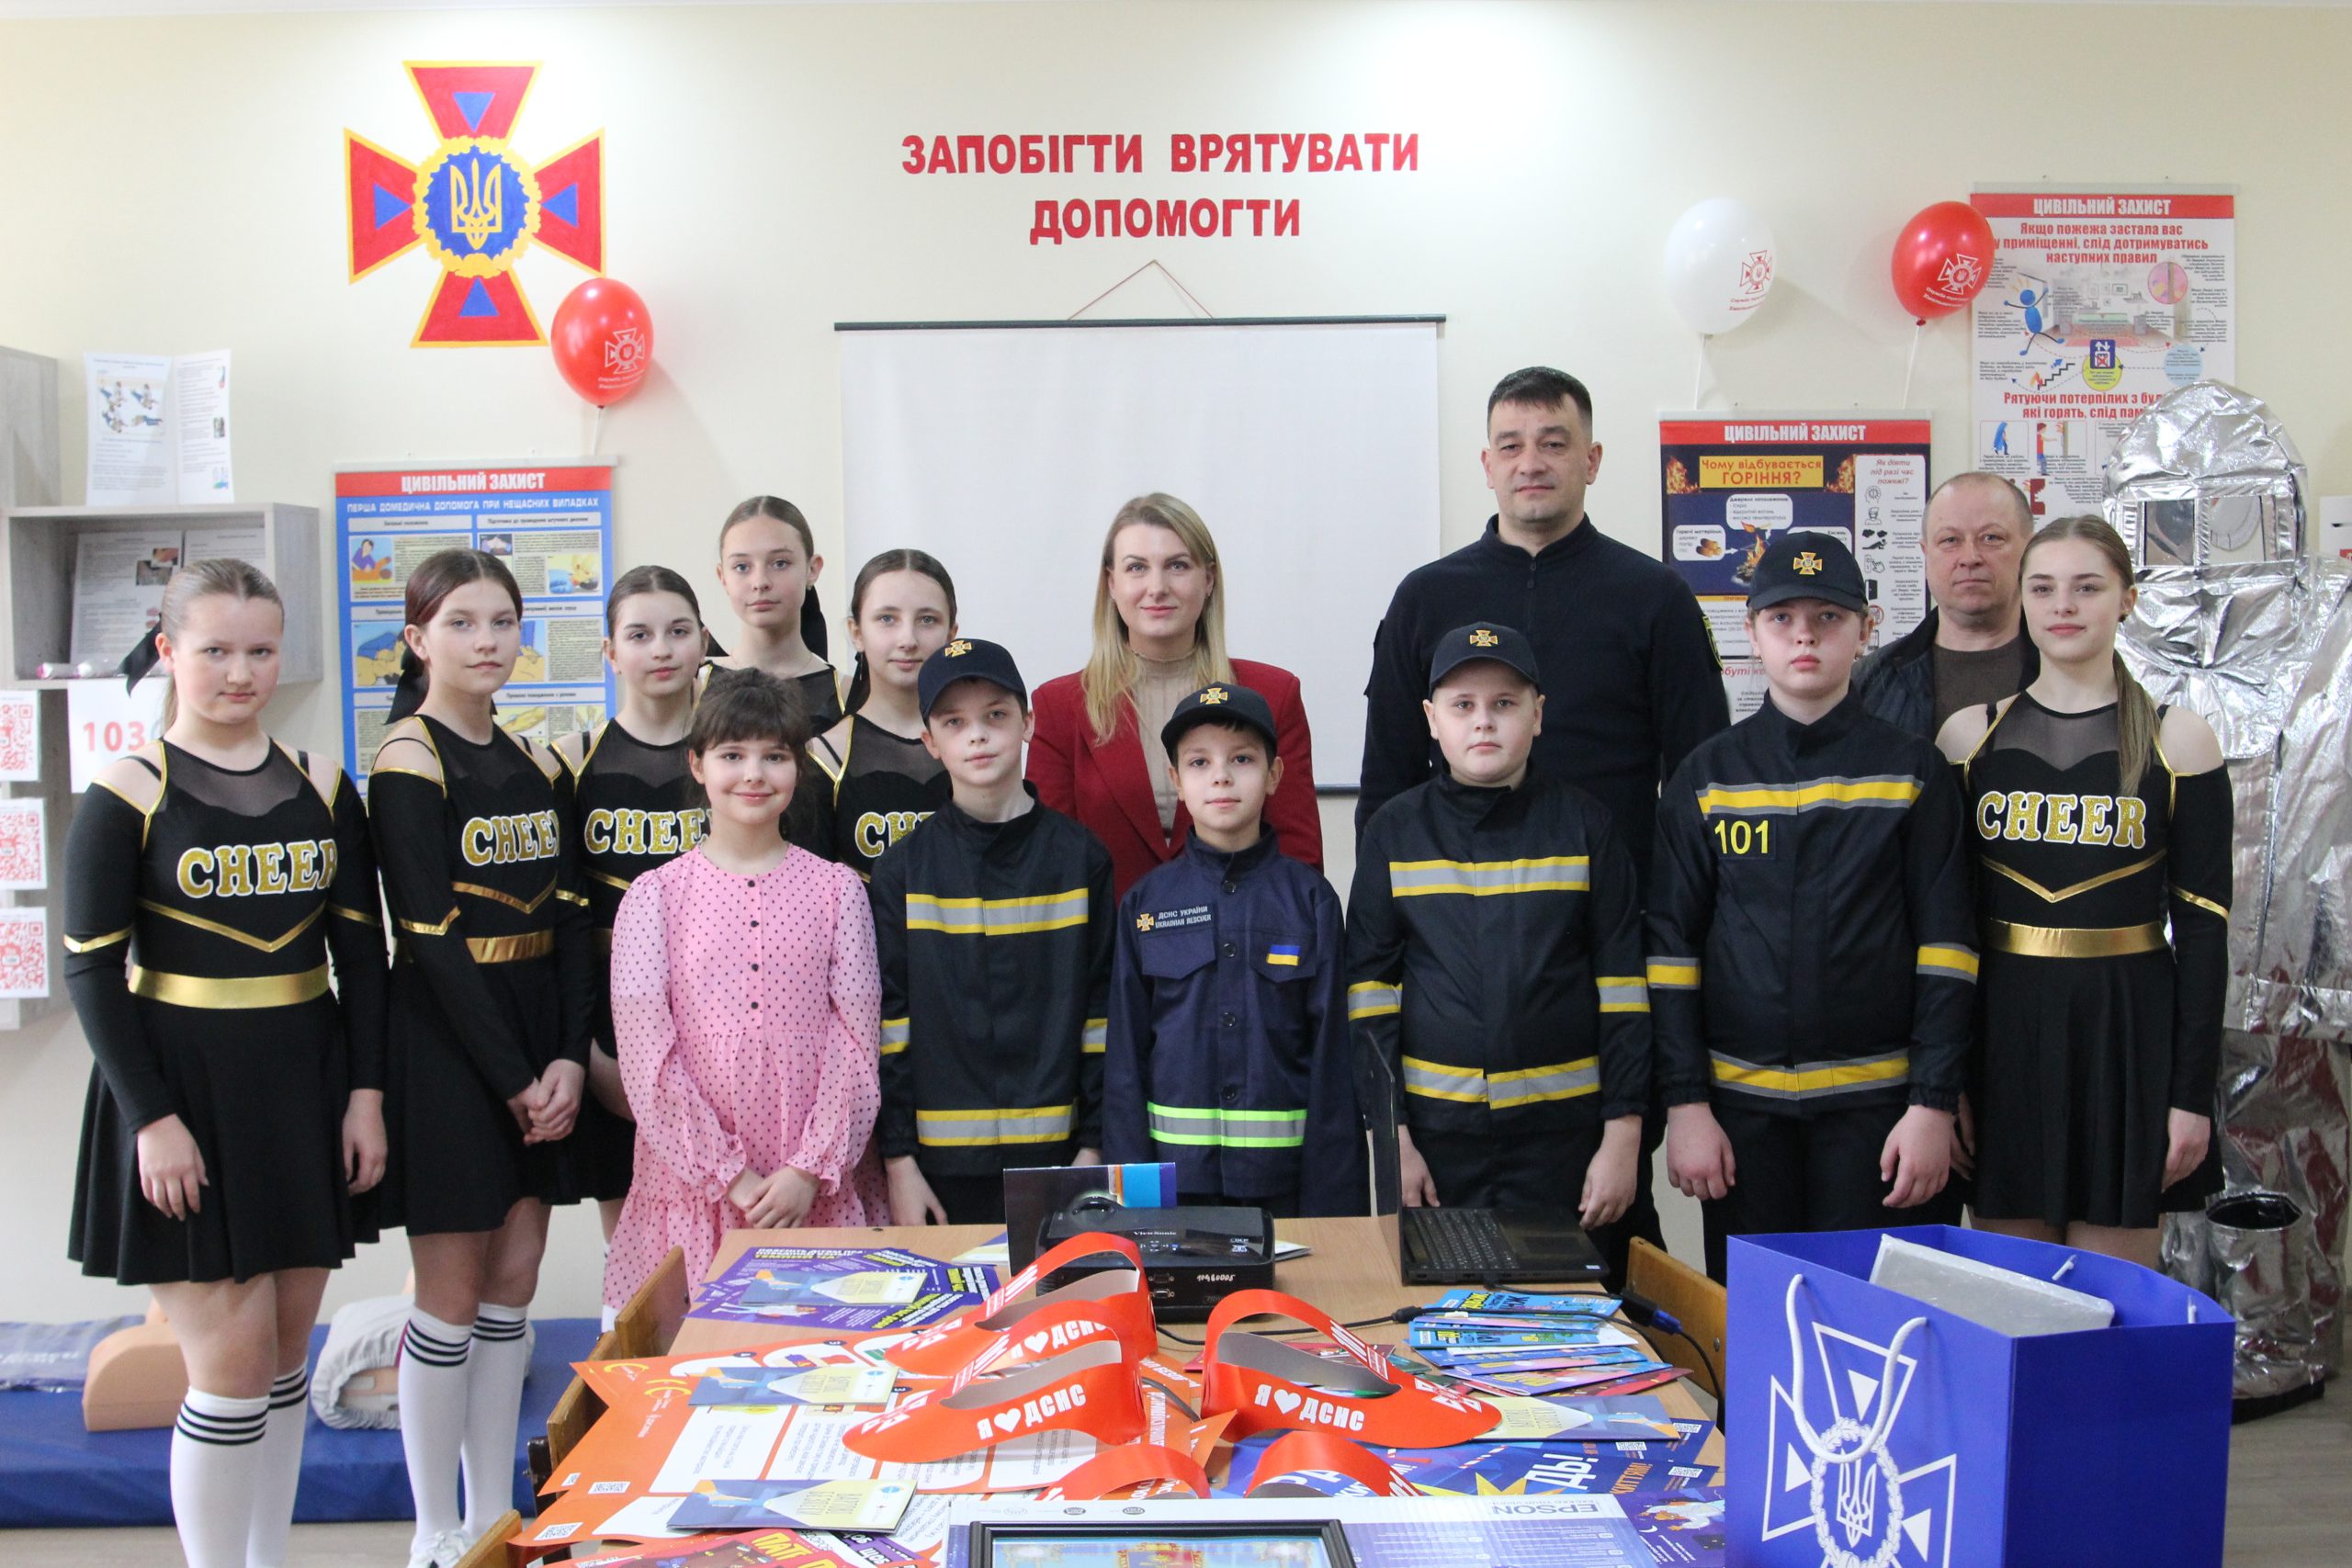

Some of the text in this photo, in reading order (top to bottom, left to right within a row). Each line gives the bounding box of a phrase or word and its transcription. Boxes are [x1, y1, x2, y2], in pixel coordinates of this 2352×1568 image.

[901, 133, 1419, 175] ЗАПОБІГТИ ВРЯТУВАТИ
[2033, 197, 2172, 215] ЦИВІЛЬНИЙ ЗАХИСТ
[1030, 198, 1301, 245] ДОПОМОГТИ
[2020, 222, 2183, 236] Якщо пожежа застала вас
[2003, 237, 2081, 252] приміщенні,
[2083, 238, 2110, 252] слід
[2113, 240, 2209, 252] дотримуватись
[2046, 253, 2157, 265] наступних правил
[2004, 392, 2056, 406] Рятуючи
[2059, 391, 2129, 405] потерпілих
[2023, 407, 2041, 419] які
[2089, 406, 2117, 420] слід
[1724, 423, 1866, 444] ЦИВІЛЬНИЙ ЗАХИСТ
[1702, 459, 1822, 471] Чому відбувається
[401, 471, 546, 494] ЦИВІЛЬНИЙ ЗАХИСТ
[1723, 471, 1802, 485] ГОРІННЯ?
[347, 497, 599, 513] ПЕРША ДОМЕДИЧНА ДОПОМОГА ПРИ НЕЩАСНИХ ВИПАДКАХ
[84, 720, 146, 752] 103
[1976, 791, 2147, 849] CHEER
[584, 807, 711, 854] CHEE
[1713, 819, 1770, 855] 101
[1158, 910, 1178, 919] ДСНС
[976, 1383, 1087, 1441] Я ДСНС
[1255, 1384, 1364, 1431] Я ДСНС
[1491, 1503, 1599, 1515] EPSON
